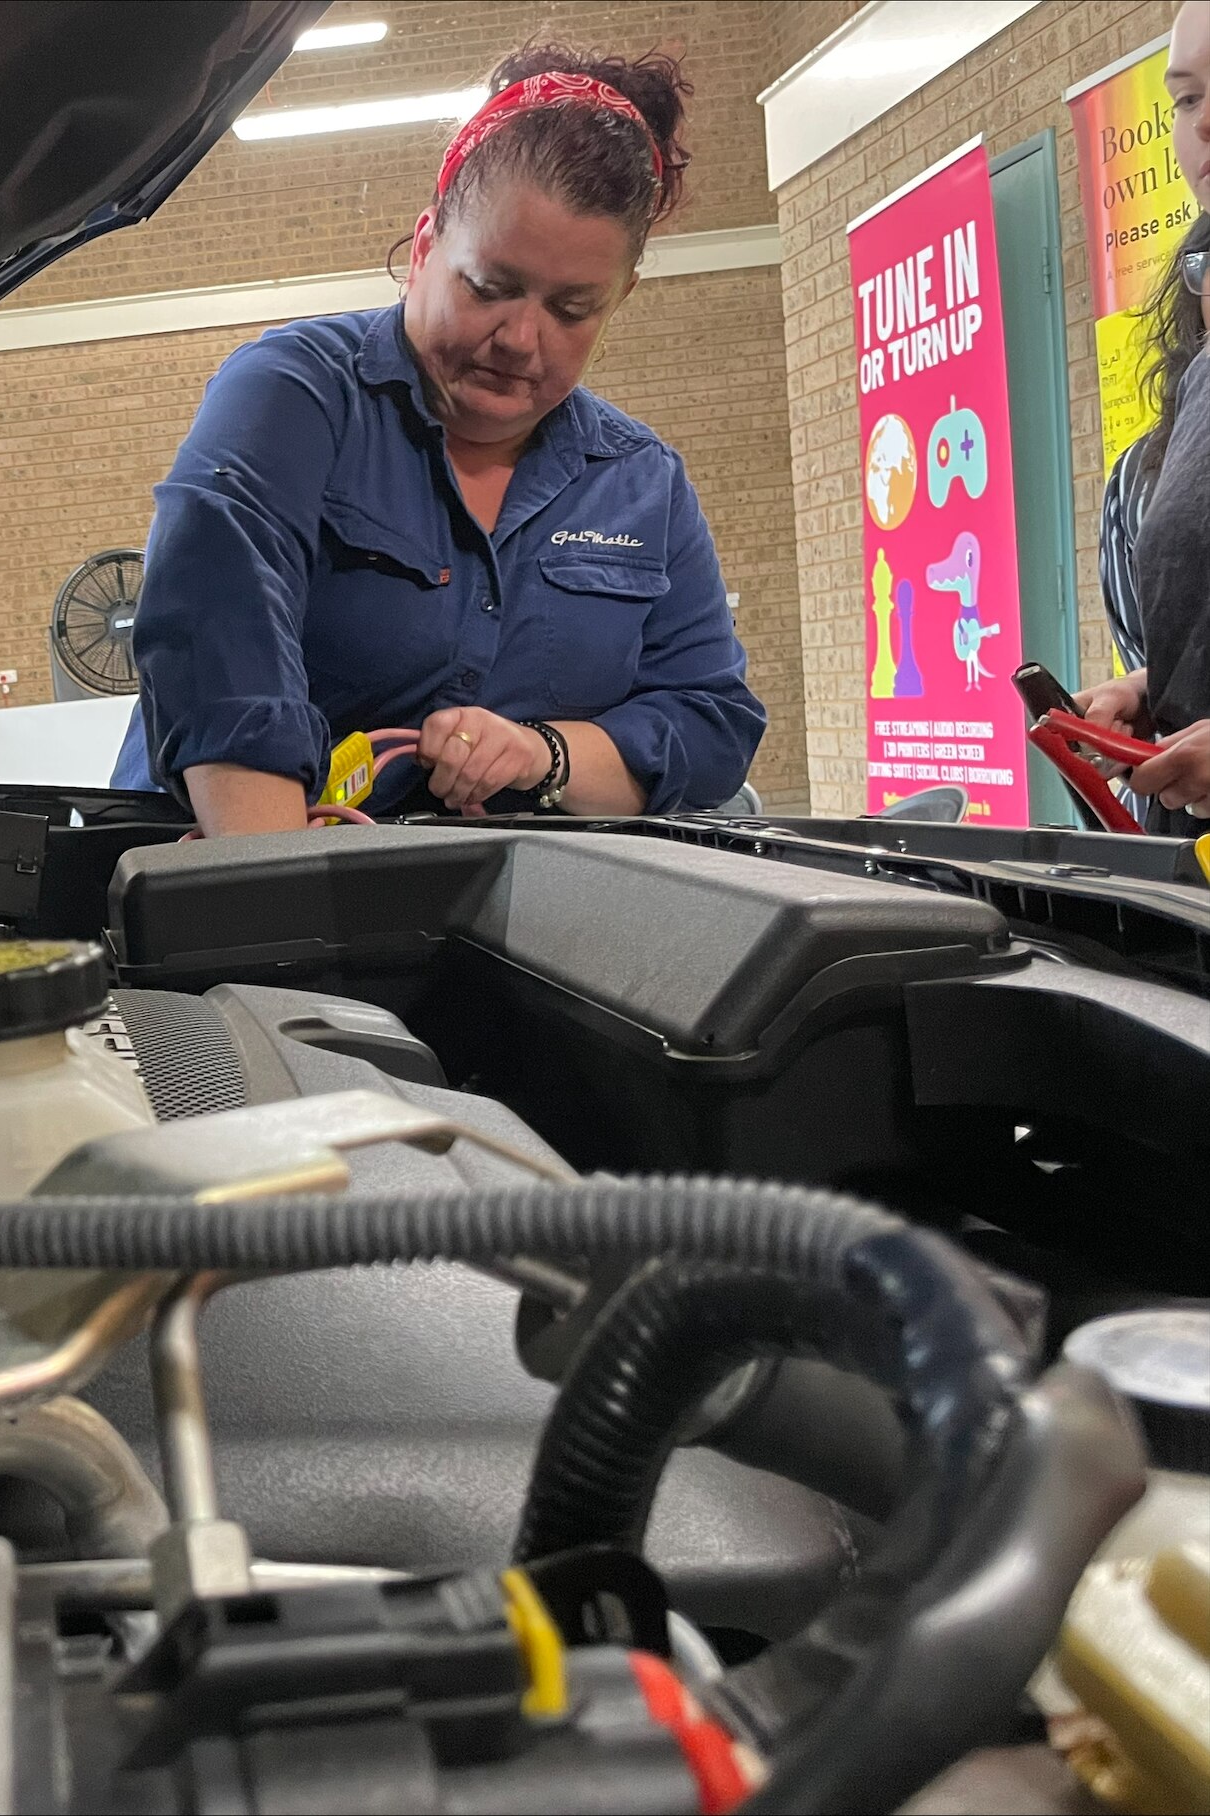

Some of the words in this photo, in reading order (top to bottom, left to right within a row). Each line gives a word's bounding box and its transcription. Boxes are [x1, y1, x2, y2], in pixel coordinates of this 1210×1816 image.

[1103, 167, 1158, 210] own
[1106, 219, 1159, 252] Please
[1165, 201, 1192, 229] ask
[858, 245, 937, 349] TUNE
[943, 220, 980, 310] IN
[860, 348, 885, 394] OR
[887, 318, 948, 381] TURN
[949, 304, 982, 355] UP
[874, 720, 891, 736] FREE
